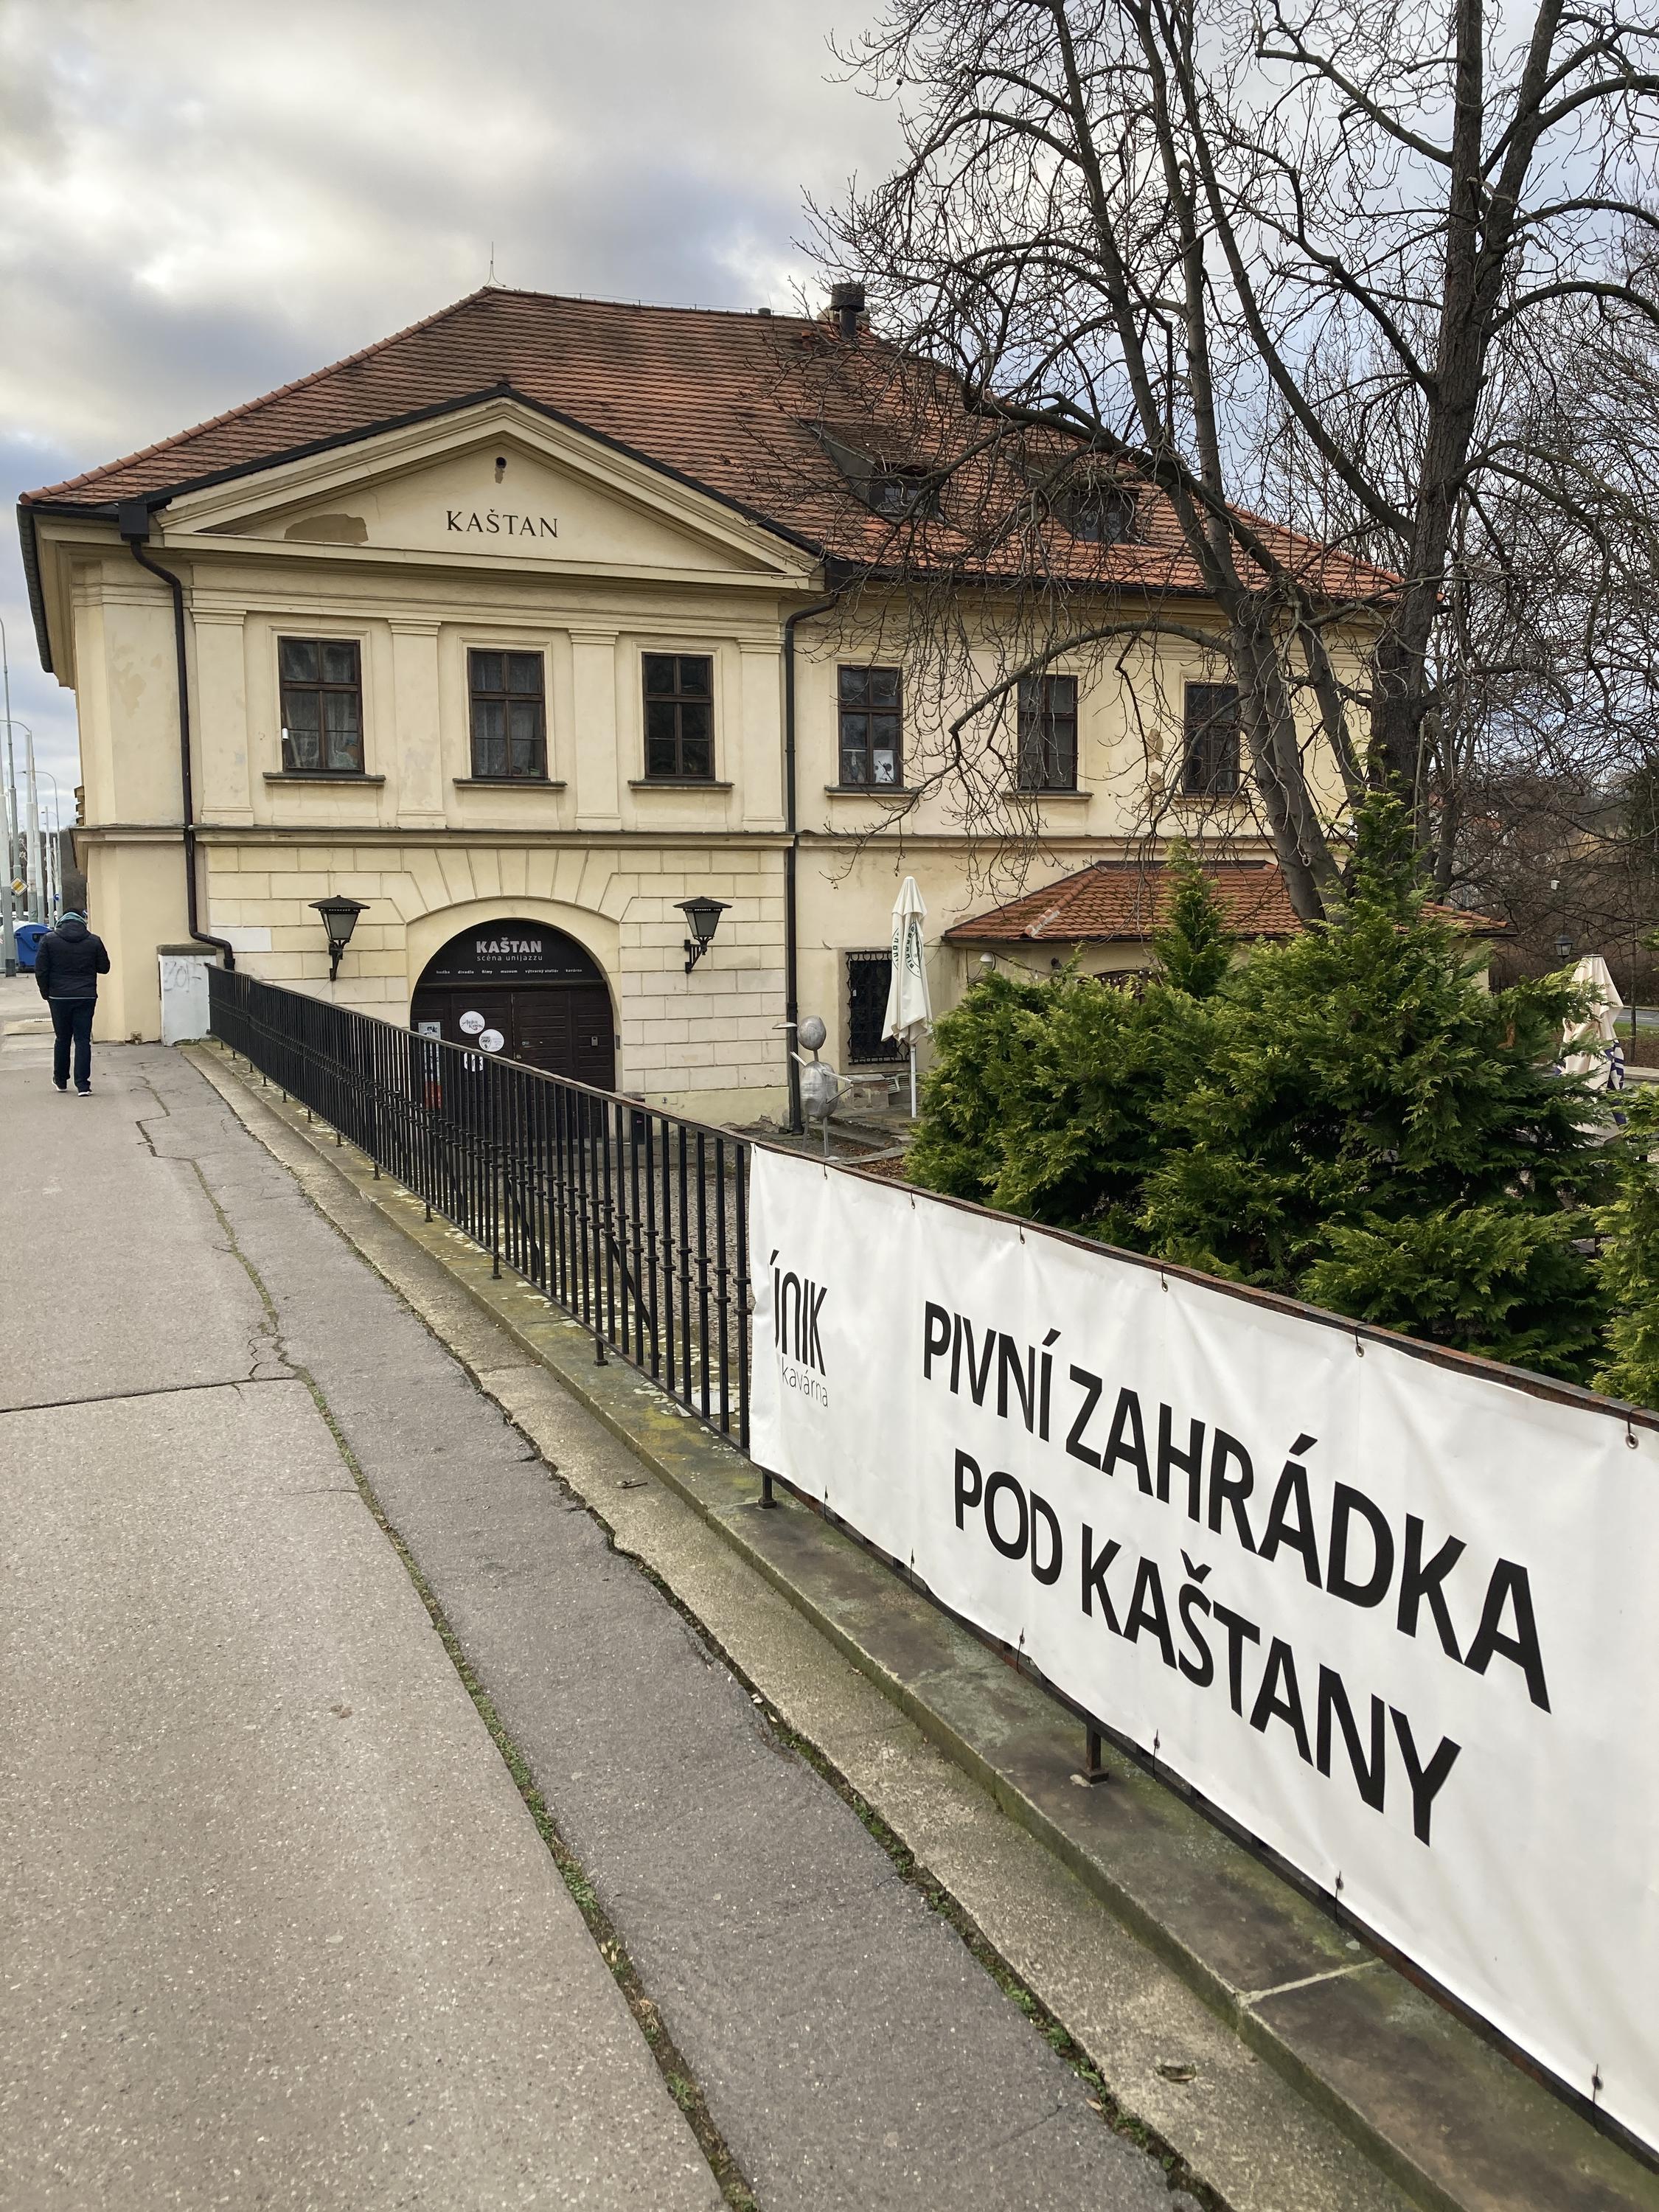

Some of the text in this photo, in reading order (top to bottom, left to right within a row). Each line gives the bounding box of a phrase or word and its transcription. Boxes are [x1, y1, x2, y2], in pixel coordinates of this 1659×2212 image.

[446, 508, 558, 538] KAŠTAN
[476, 937, 542, 953] KAŠTAN
[505, 954, 543, 962] unijazzu
[782, 1356, 830, 1409] kavárna
[924, 1301, 1551, 1714] PIVNÍ ZAHRÁDKA
[953, 1447, 1461, 1847] POD KAŠTANY
